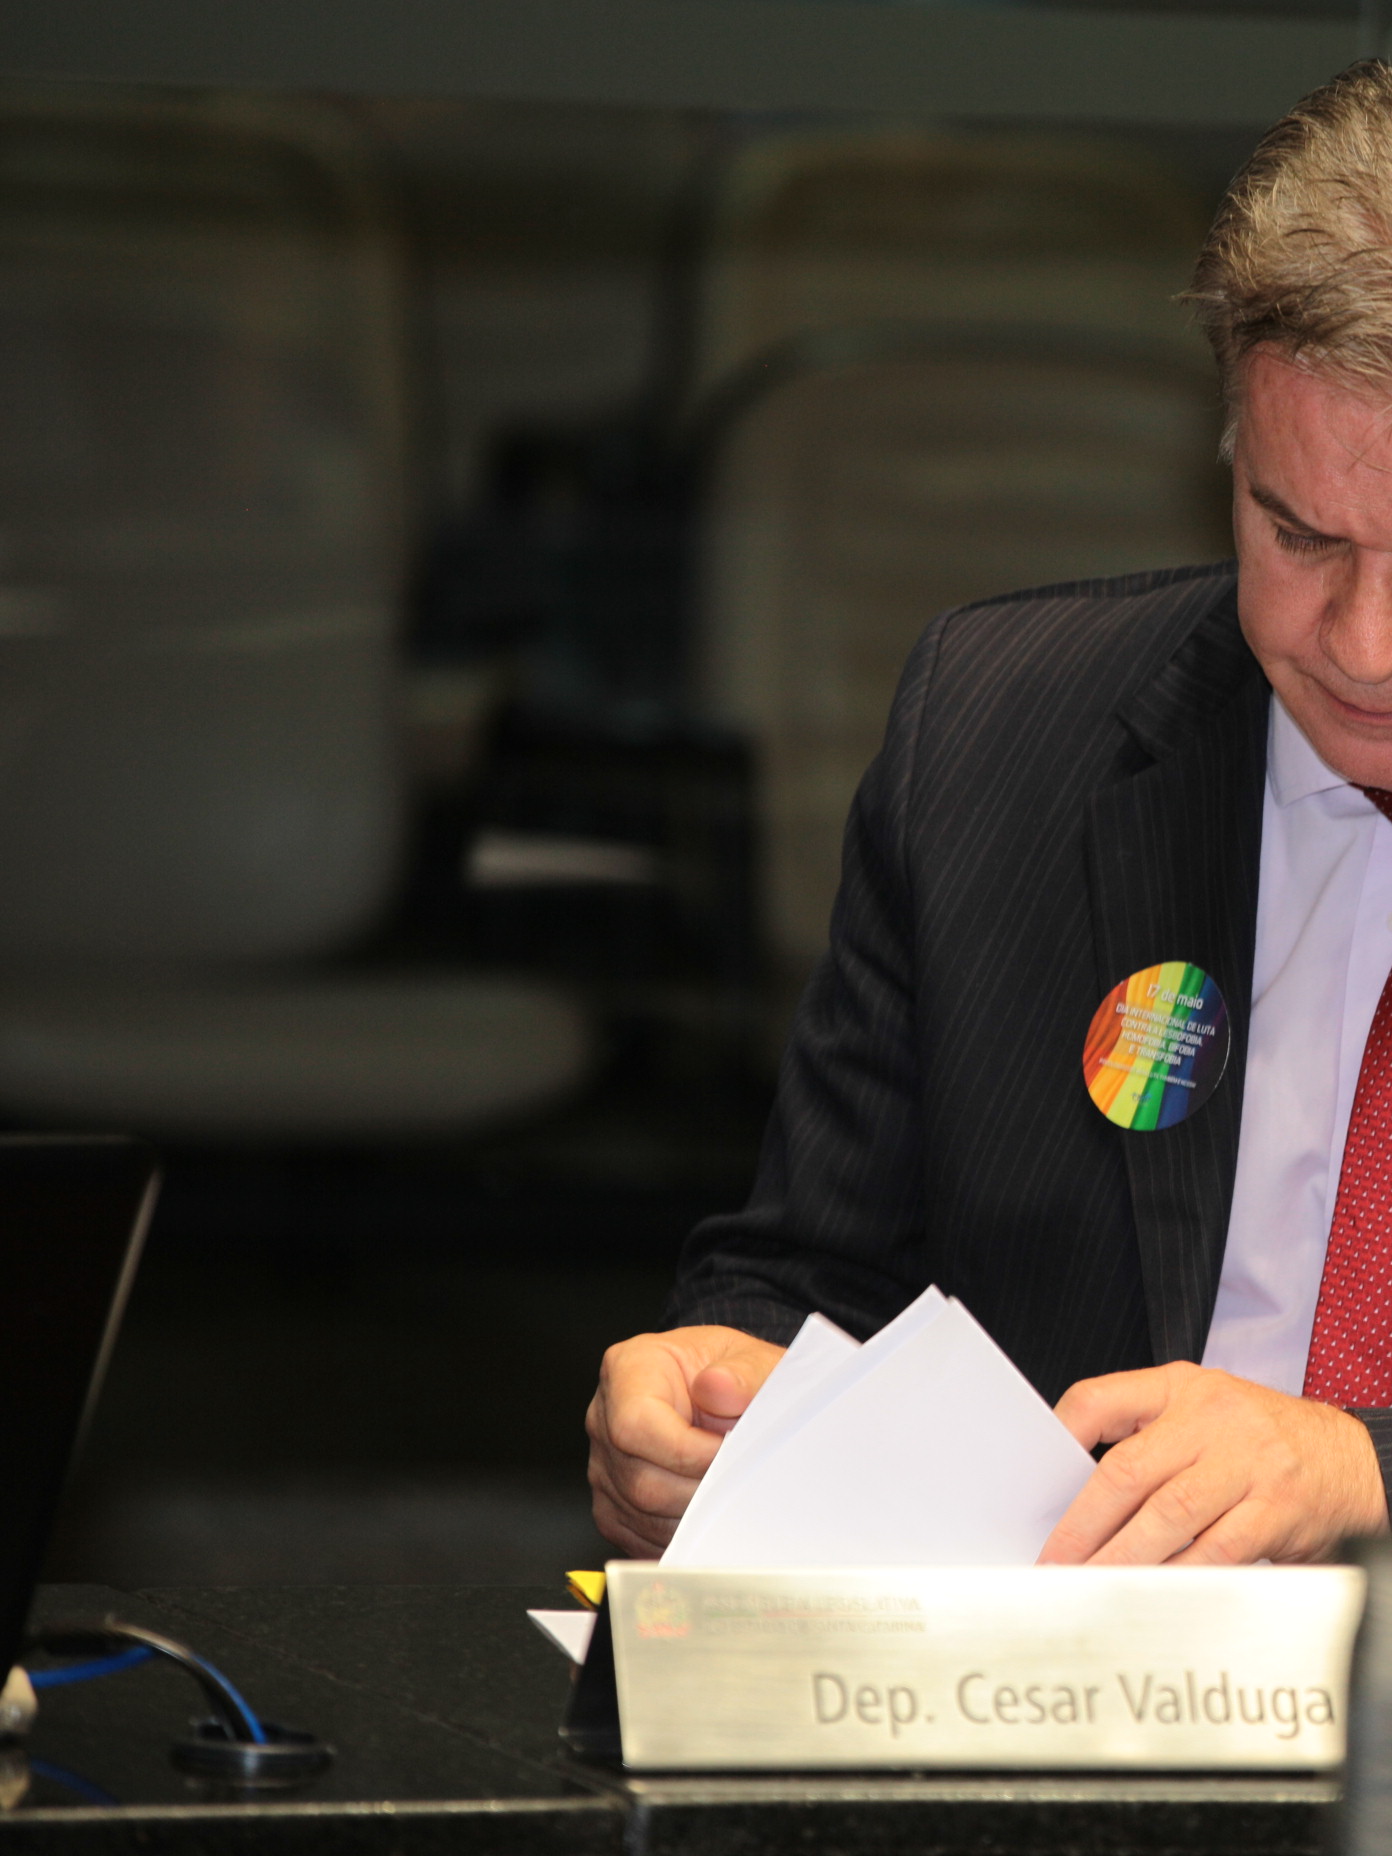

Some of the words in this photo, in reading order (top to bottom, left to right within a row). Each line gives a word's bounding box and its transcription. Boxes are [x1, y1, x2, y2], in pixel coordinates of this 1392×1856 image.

[1147, 984, 1160, 998] 17
[1162, 989, 1175, 1003] de
[1177, 994, 1203, 1010] maio
[1116, 1003, 1129, 1014] DIA
[1130, 1006, 1186, 1029] INTERNACIONAL
[1187, 1021, 1198, 1032] DE
[1197, 1024, 1215, 1036] LUTA
[1121, 1016, 1152, 1032] CONTRA
[811, 1671, 935, 1738] Dep.
[956, 1672, 1101, 1724] Cesar
[1117, 1670, 1336, 1740] Valduga
